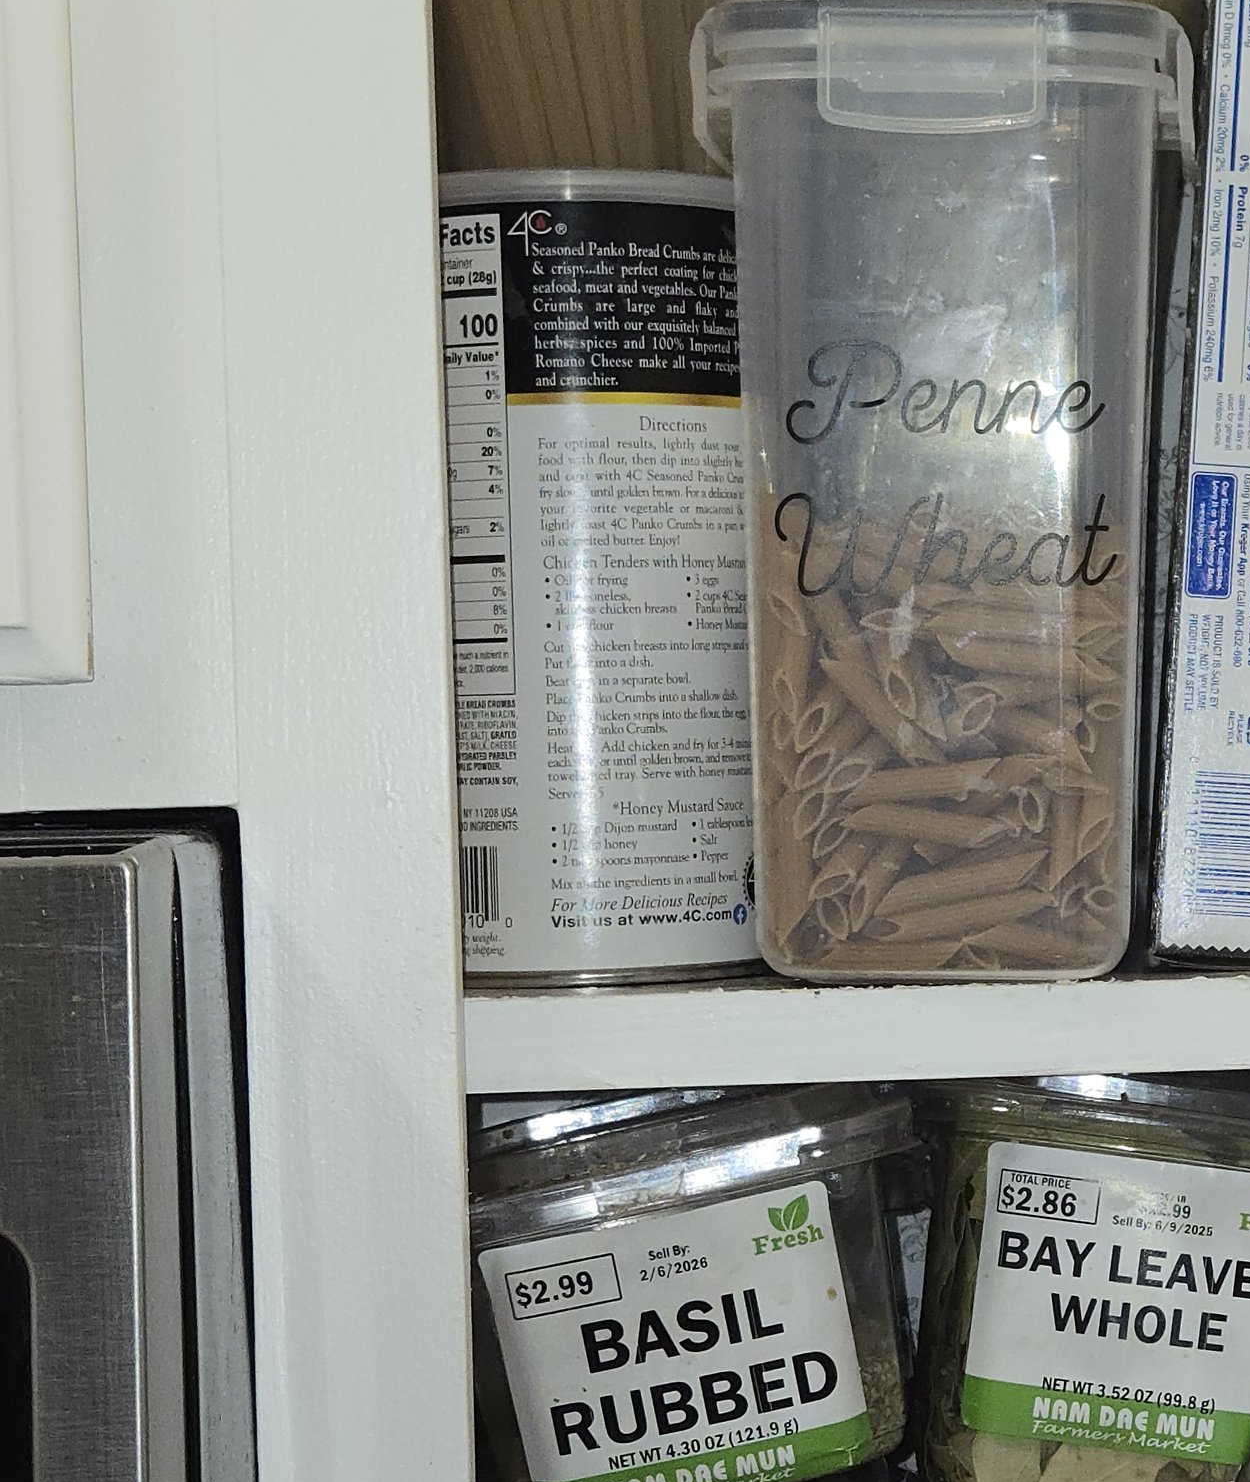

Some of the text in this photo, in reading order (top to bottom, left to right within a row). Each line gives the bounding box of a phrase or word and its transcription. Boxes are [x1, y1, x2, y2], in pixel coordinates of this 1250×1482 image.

[531, 242, 716, 261] Seasoned Panko Bread Crumbs are
[460, 313, 498, 338] 100
[536, 353, 711, 372] Romano Cheese make all your
[786, 339, 1106, 445] Penne
[639, 416, 708, 432] Directions
[774, 492, 1117, 597] Wheat
[668, 798, 744, 813] Mustard Sauce
[551, 899, 577, 912] For
[622, 895, 682, 910] Delicious
[687, 893, 728, 908] Recipes
[551, 910, 732, 928] Visit us at www.4C.com
[1001, 1185, 1077, 1218] $2.86
[752, 1225, 824, 1256] Fresh
[1112, 1215, 1213, 1237] Sell By: 6/9/2025
[640, 1257, 709, 1282] 2/6/2026
[998, 1230, 1095, 1278] BAY
[516, 1271, 594, 1308] $2.99
[580, 1289, 784, 1374] BASIL
[1051, 1292, 1229, 1352] WHOLE
[550, 1351, 838, 1456] RUBBED
[734, 1445, 796, 1476] MUN
